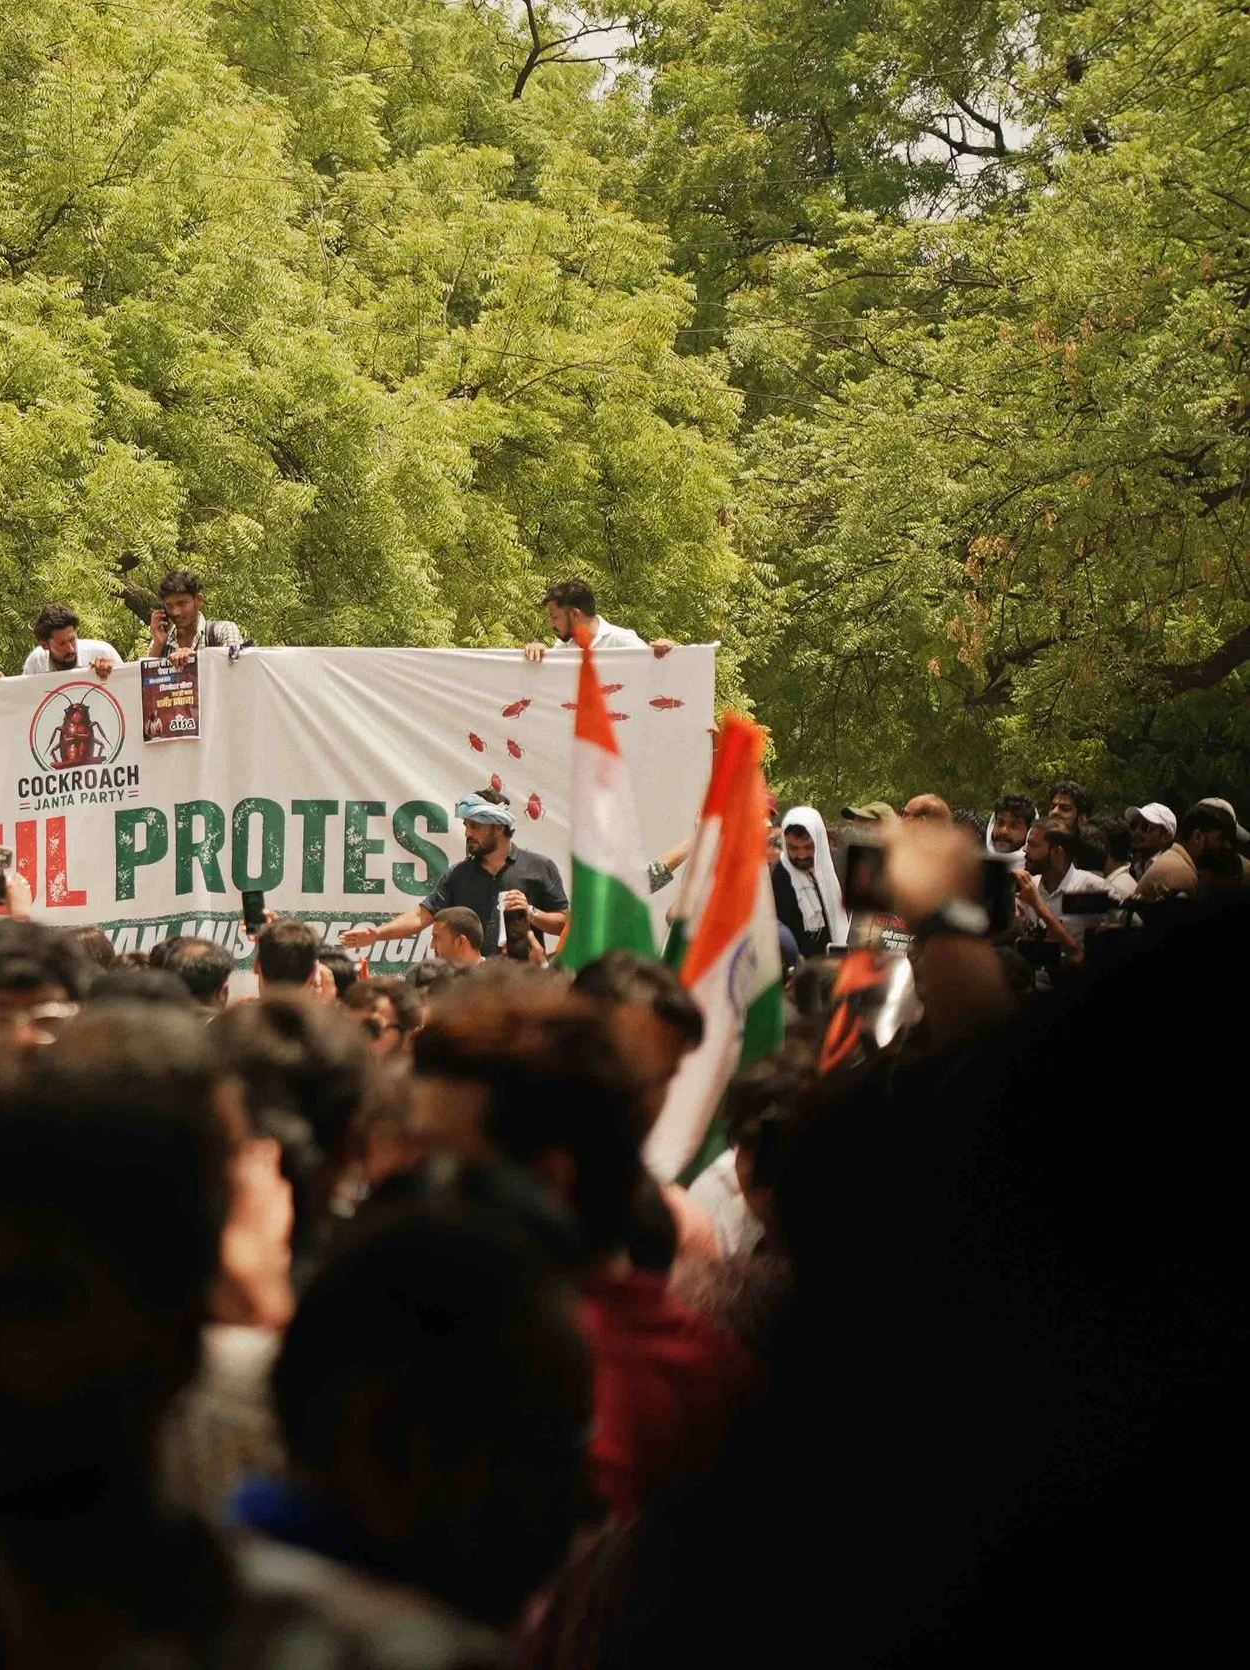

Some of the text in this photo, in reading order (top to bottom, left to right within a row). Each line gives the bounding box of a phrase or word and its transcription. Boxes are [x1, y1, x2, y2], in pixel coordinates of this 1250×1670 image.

[170, 718, 196, 731] aisa
[18, 765, 139, 798] COCKROACH
[34, 789, 125, 811] JANTA PARTY
[114, 797, 458, 902] PROTES
[181, 919, 260, 961] MUS
